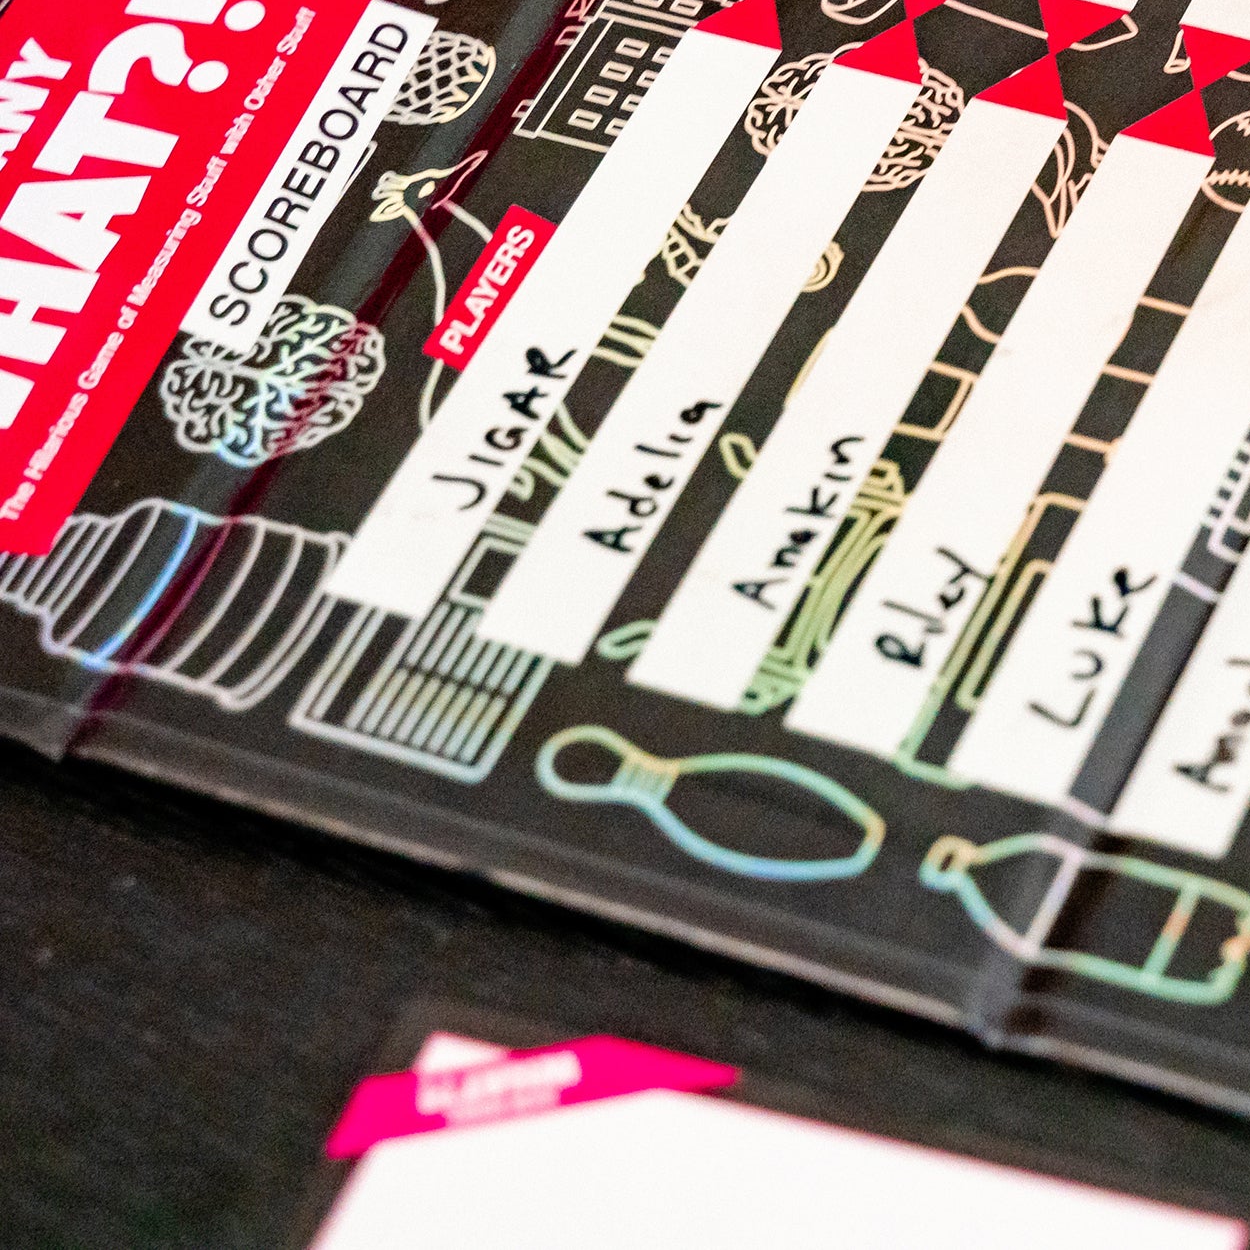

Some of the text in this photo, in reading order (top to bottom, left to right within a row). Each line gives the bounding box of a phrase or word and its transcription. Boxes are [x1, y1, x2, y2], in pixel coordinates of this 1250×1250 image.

[276, 6, 316, 55] Stuff
[243, 56, 286, 110] Other
[209, 21, 408, 327] SCOREBOARD
[219, 113, 255, 155] with
[186, 155, 228, 207] Stuff
[126, 208, 202, 306] Measuring
[439, 225, 535, 355] PLAYERS
[77, 332, 124, 390] Game
[117, 305, 138, 329] of
[23, 392, 89, 481] Hilarious
[430, 346, 578, 510] JIGAR
[583, 398, 724, 553] Adelia
[731, 433, 867, 611] Anakin
